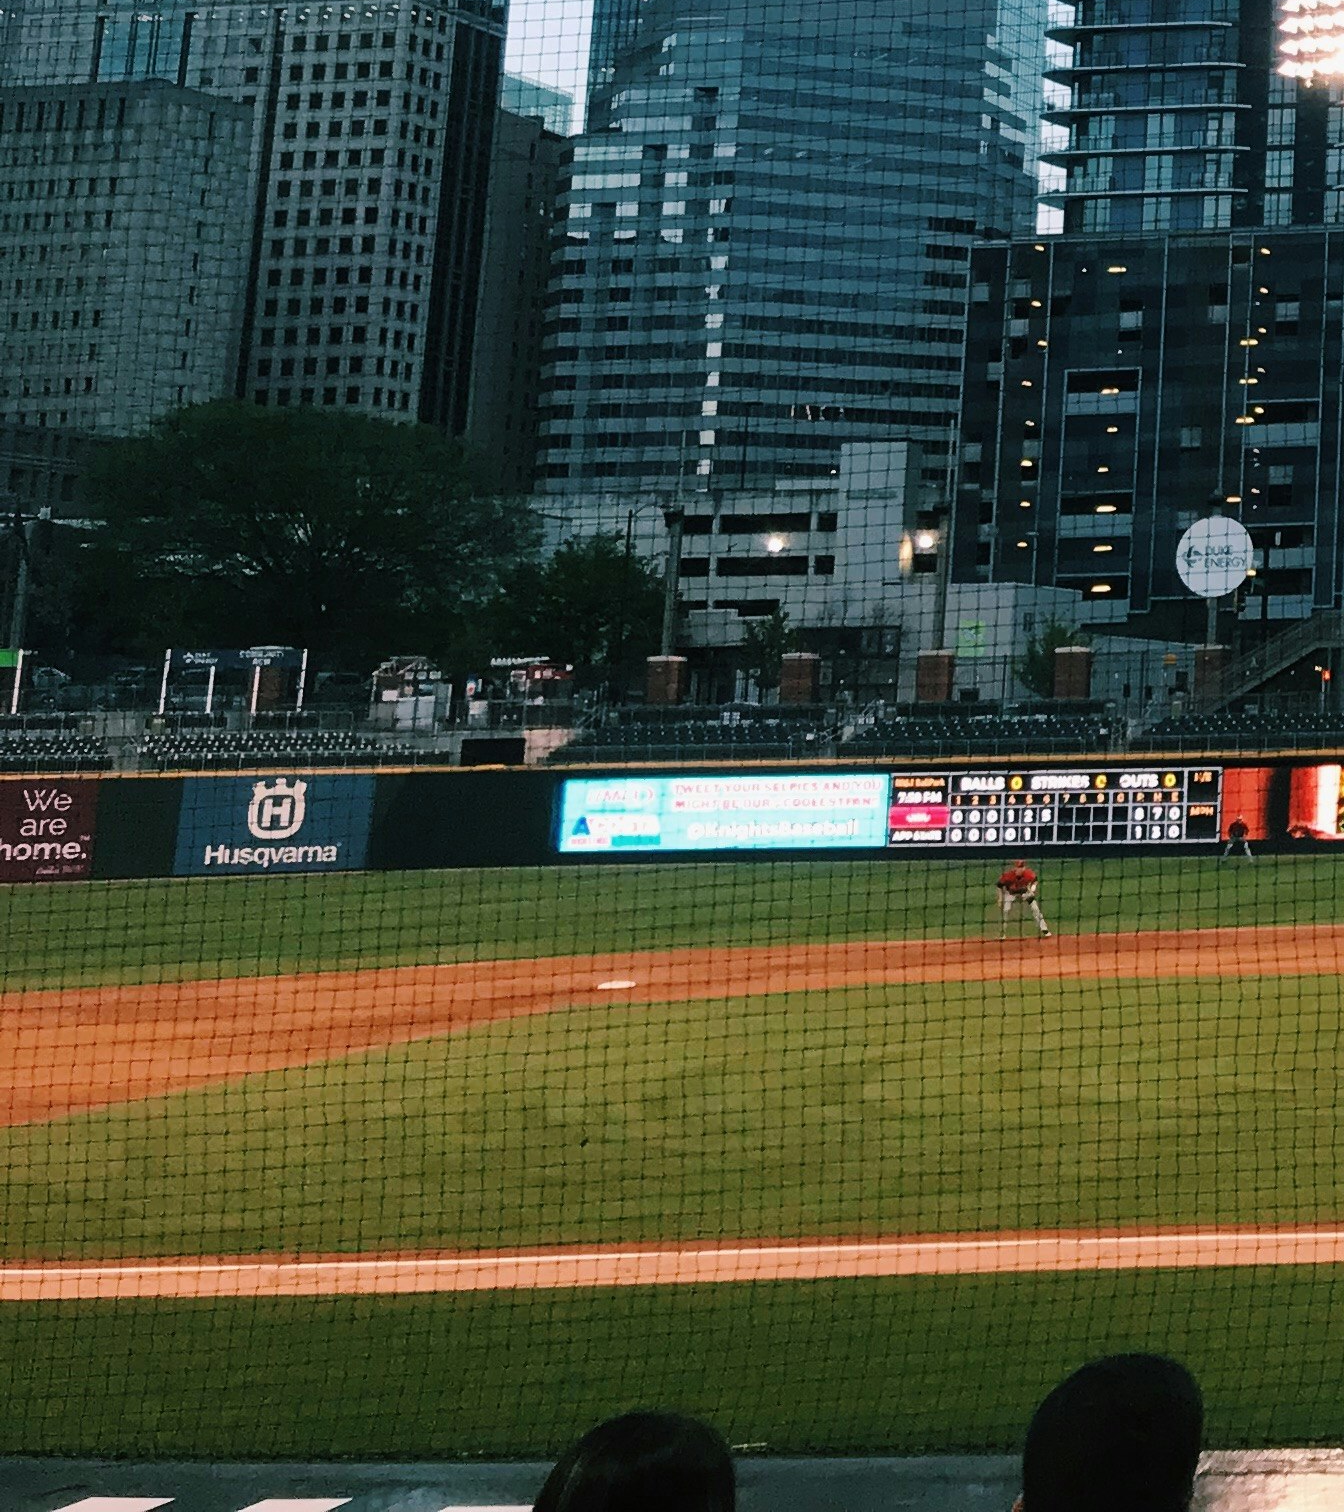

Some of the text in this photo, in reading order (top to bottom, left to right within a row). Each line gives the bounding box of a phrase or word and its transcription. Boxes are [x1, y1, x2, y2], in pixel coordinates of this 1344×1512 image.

[1205, 557, 1246, 568] ENERGY
[724, 782, 760, 793] YOUR
[960, 777, 1005, 791] BALLS
[1011, 776, 1023, 790] 0
[1030, 774, 1090, 790] STRIKES
[1119, 774, 1159, 788] OUTS
[1164, 773, 1176, 788] 0
[23, 788, 73, 813] We
[952, 810, 963, 824] 0
[969, 810, 981, 823] 0
[986, 810, 998, 823] 0
[1169, 806, 1180, 820] 0
[19, 816, 68, 836] are
[951, 828, 962, 842] 0
[968, 828, 980, 842] 0
[1005, 827, 1017, 841] 0
[1168, 825, 1180, 838] 0
[204, 842, 338, 868] Husqvarna
